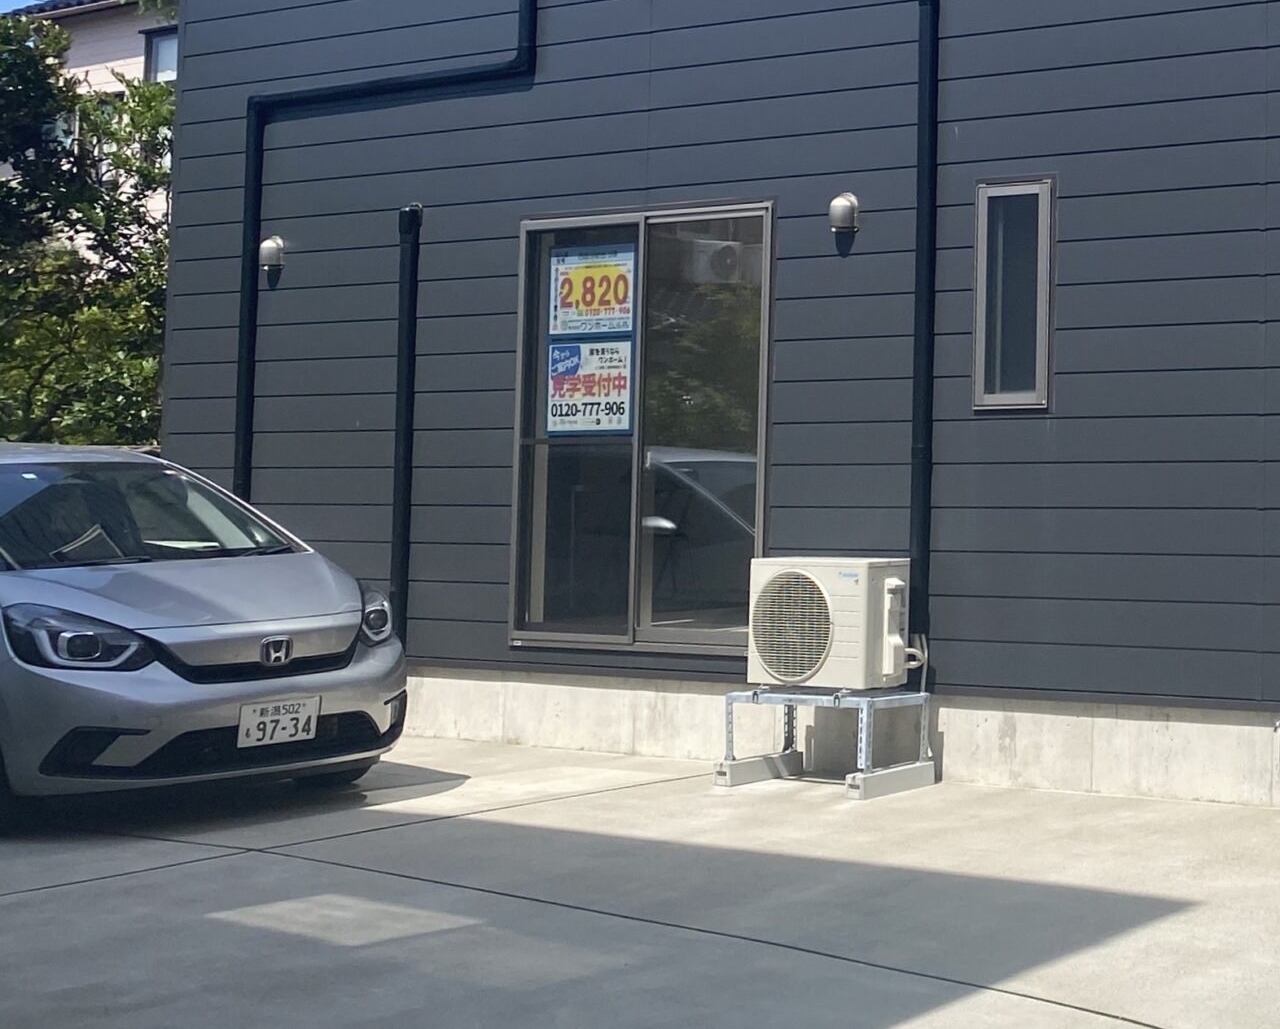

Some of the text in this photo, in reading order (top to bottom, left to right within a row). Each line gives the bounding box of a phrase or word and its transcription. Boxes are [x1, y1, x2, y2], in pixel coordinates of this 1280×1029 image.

[559, 274, 628, 309] 2,820
[551, 371, 627, 399] 見学受付中
[551, 401, 626, 418] 0120-777-906
[255, 715, 311, 741] 97-34
